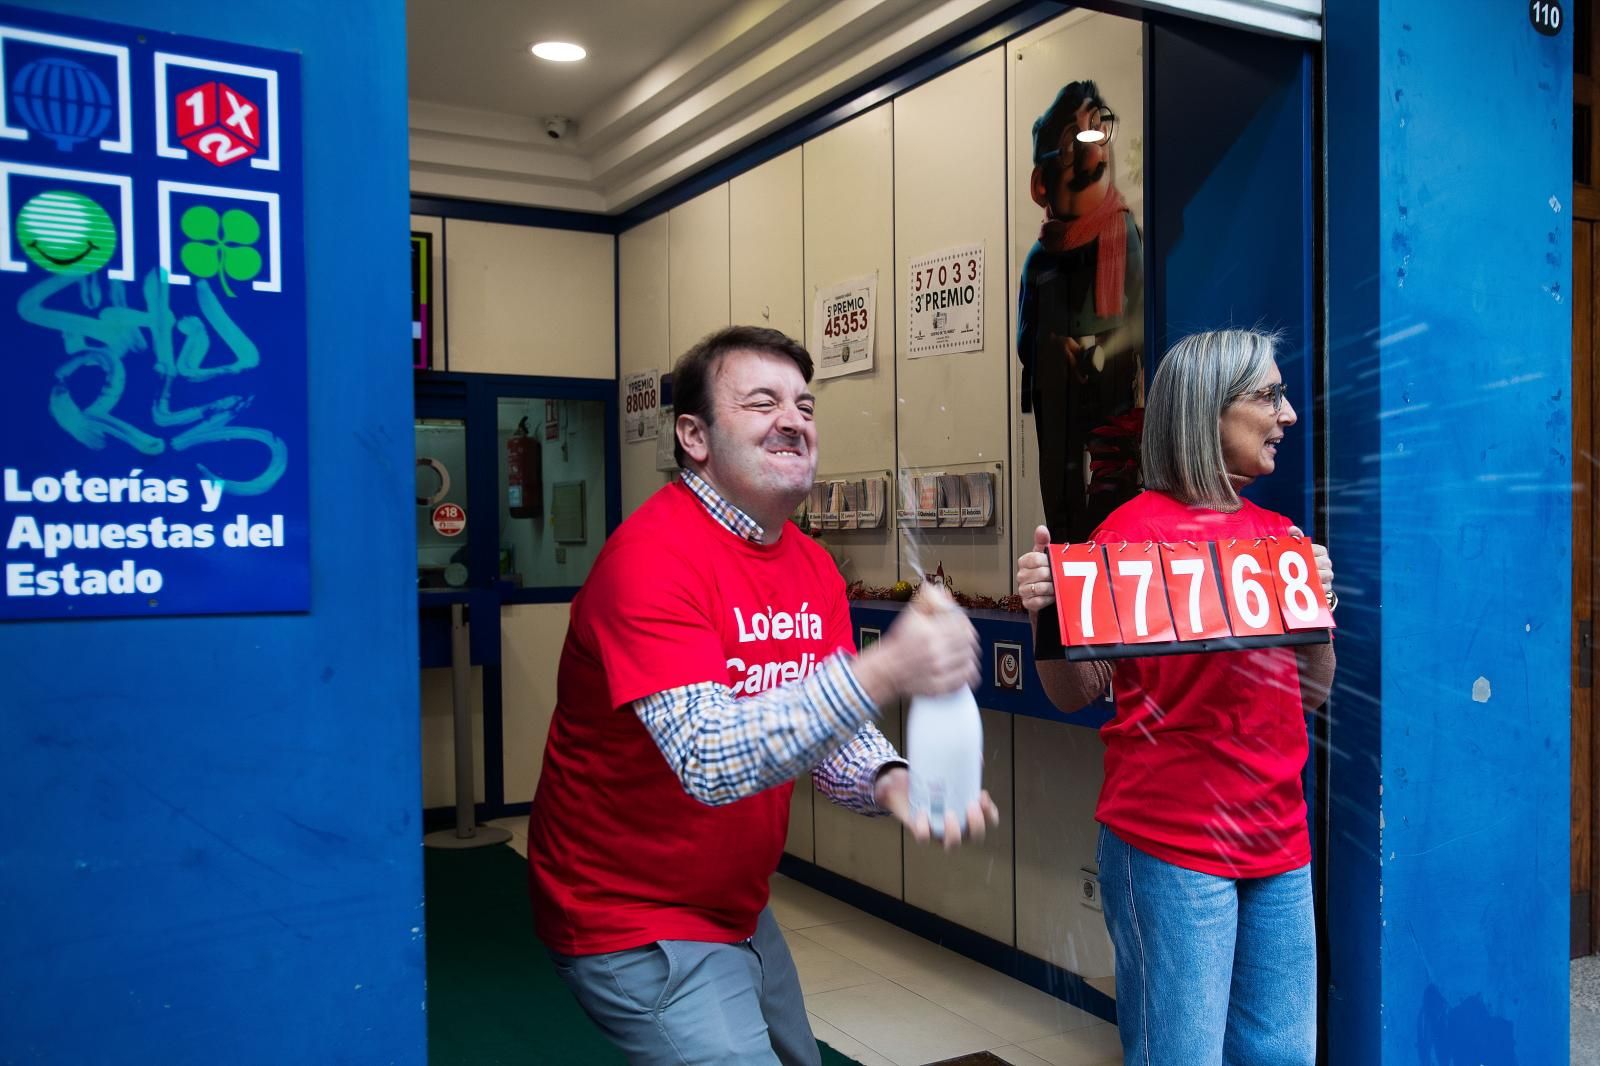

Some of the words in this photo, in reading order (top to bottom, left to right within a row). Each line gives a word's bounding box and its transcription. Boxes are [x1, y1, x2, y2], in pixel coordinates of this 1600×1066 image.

[1532, 1, 1560, 29] 110
[833, 296, 865, 316] PREMIO
[925, 285, 975, 312] PREMIO
[824, 308, 868, 339] 45353
[626, 388, 656, 414] 88008
[4, 468, 189, 504] Loterías
[200, 479, 224, 513] y
[440, 506, 458, 518] +18
[6, 515, 215, 558] Apuestas
[222, 514, 284, 548] del
[6, 559, 163, 597] Estado
[1062, 550, 1319, 638] 77768
